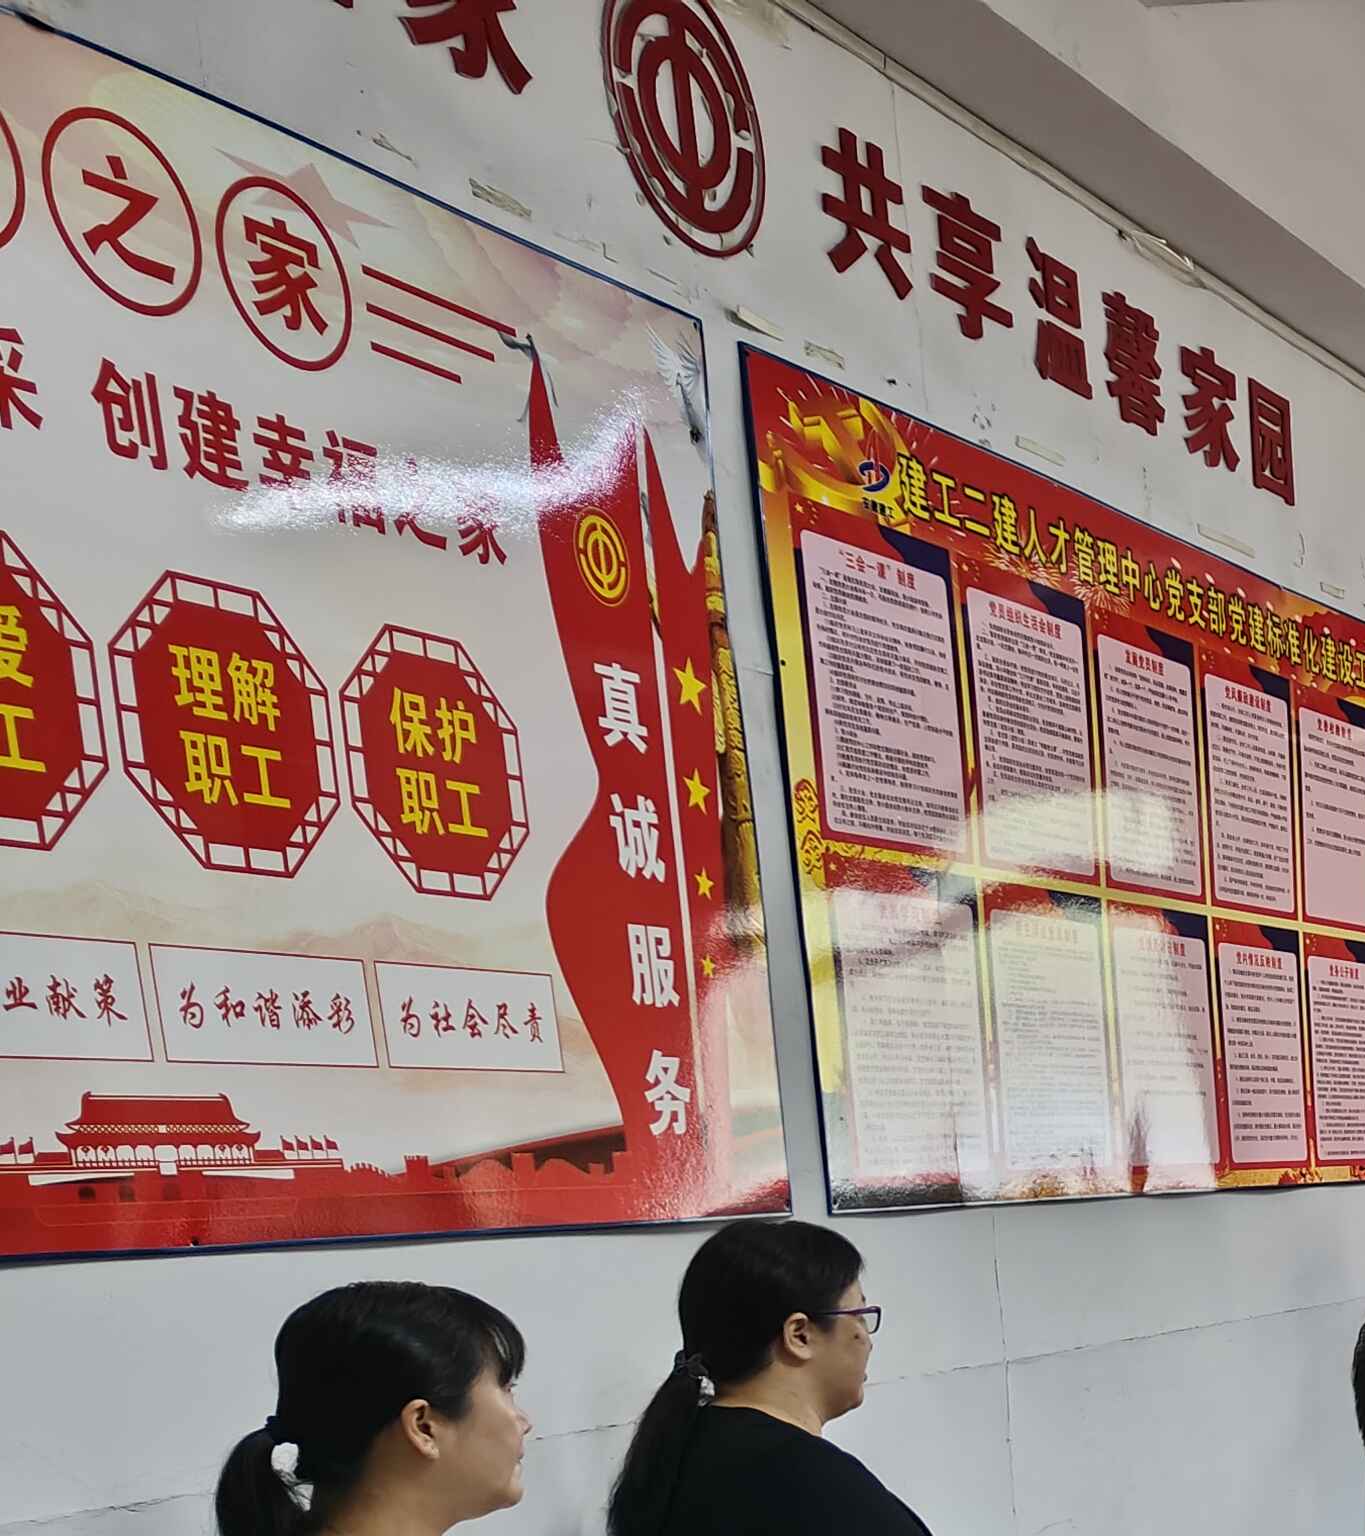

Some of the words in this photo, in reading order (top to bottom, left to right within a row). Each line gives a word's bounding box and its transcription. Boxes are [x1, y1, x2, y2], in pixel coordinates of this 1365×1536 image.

[820, 127, 1295, 506] 共享温馨家园
[168, 642, 282, 733] 理解
[388, 685, 479, 764] 保护
[179, 729, 293, 811] 职工
[397, 766, 490, 840] 职工
[591, 660, 692, 1138] 真诚服务
[2, 973, 128, 1027] 业献策
[177, 983, 358, 1037] 为和谐添彩
[399, 996, 547, 1046] 为社会尽责
